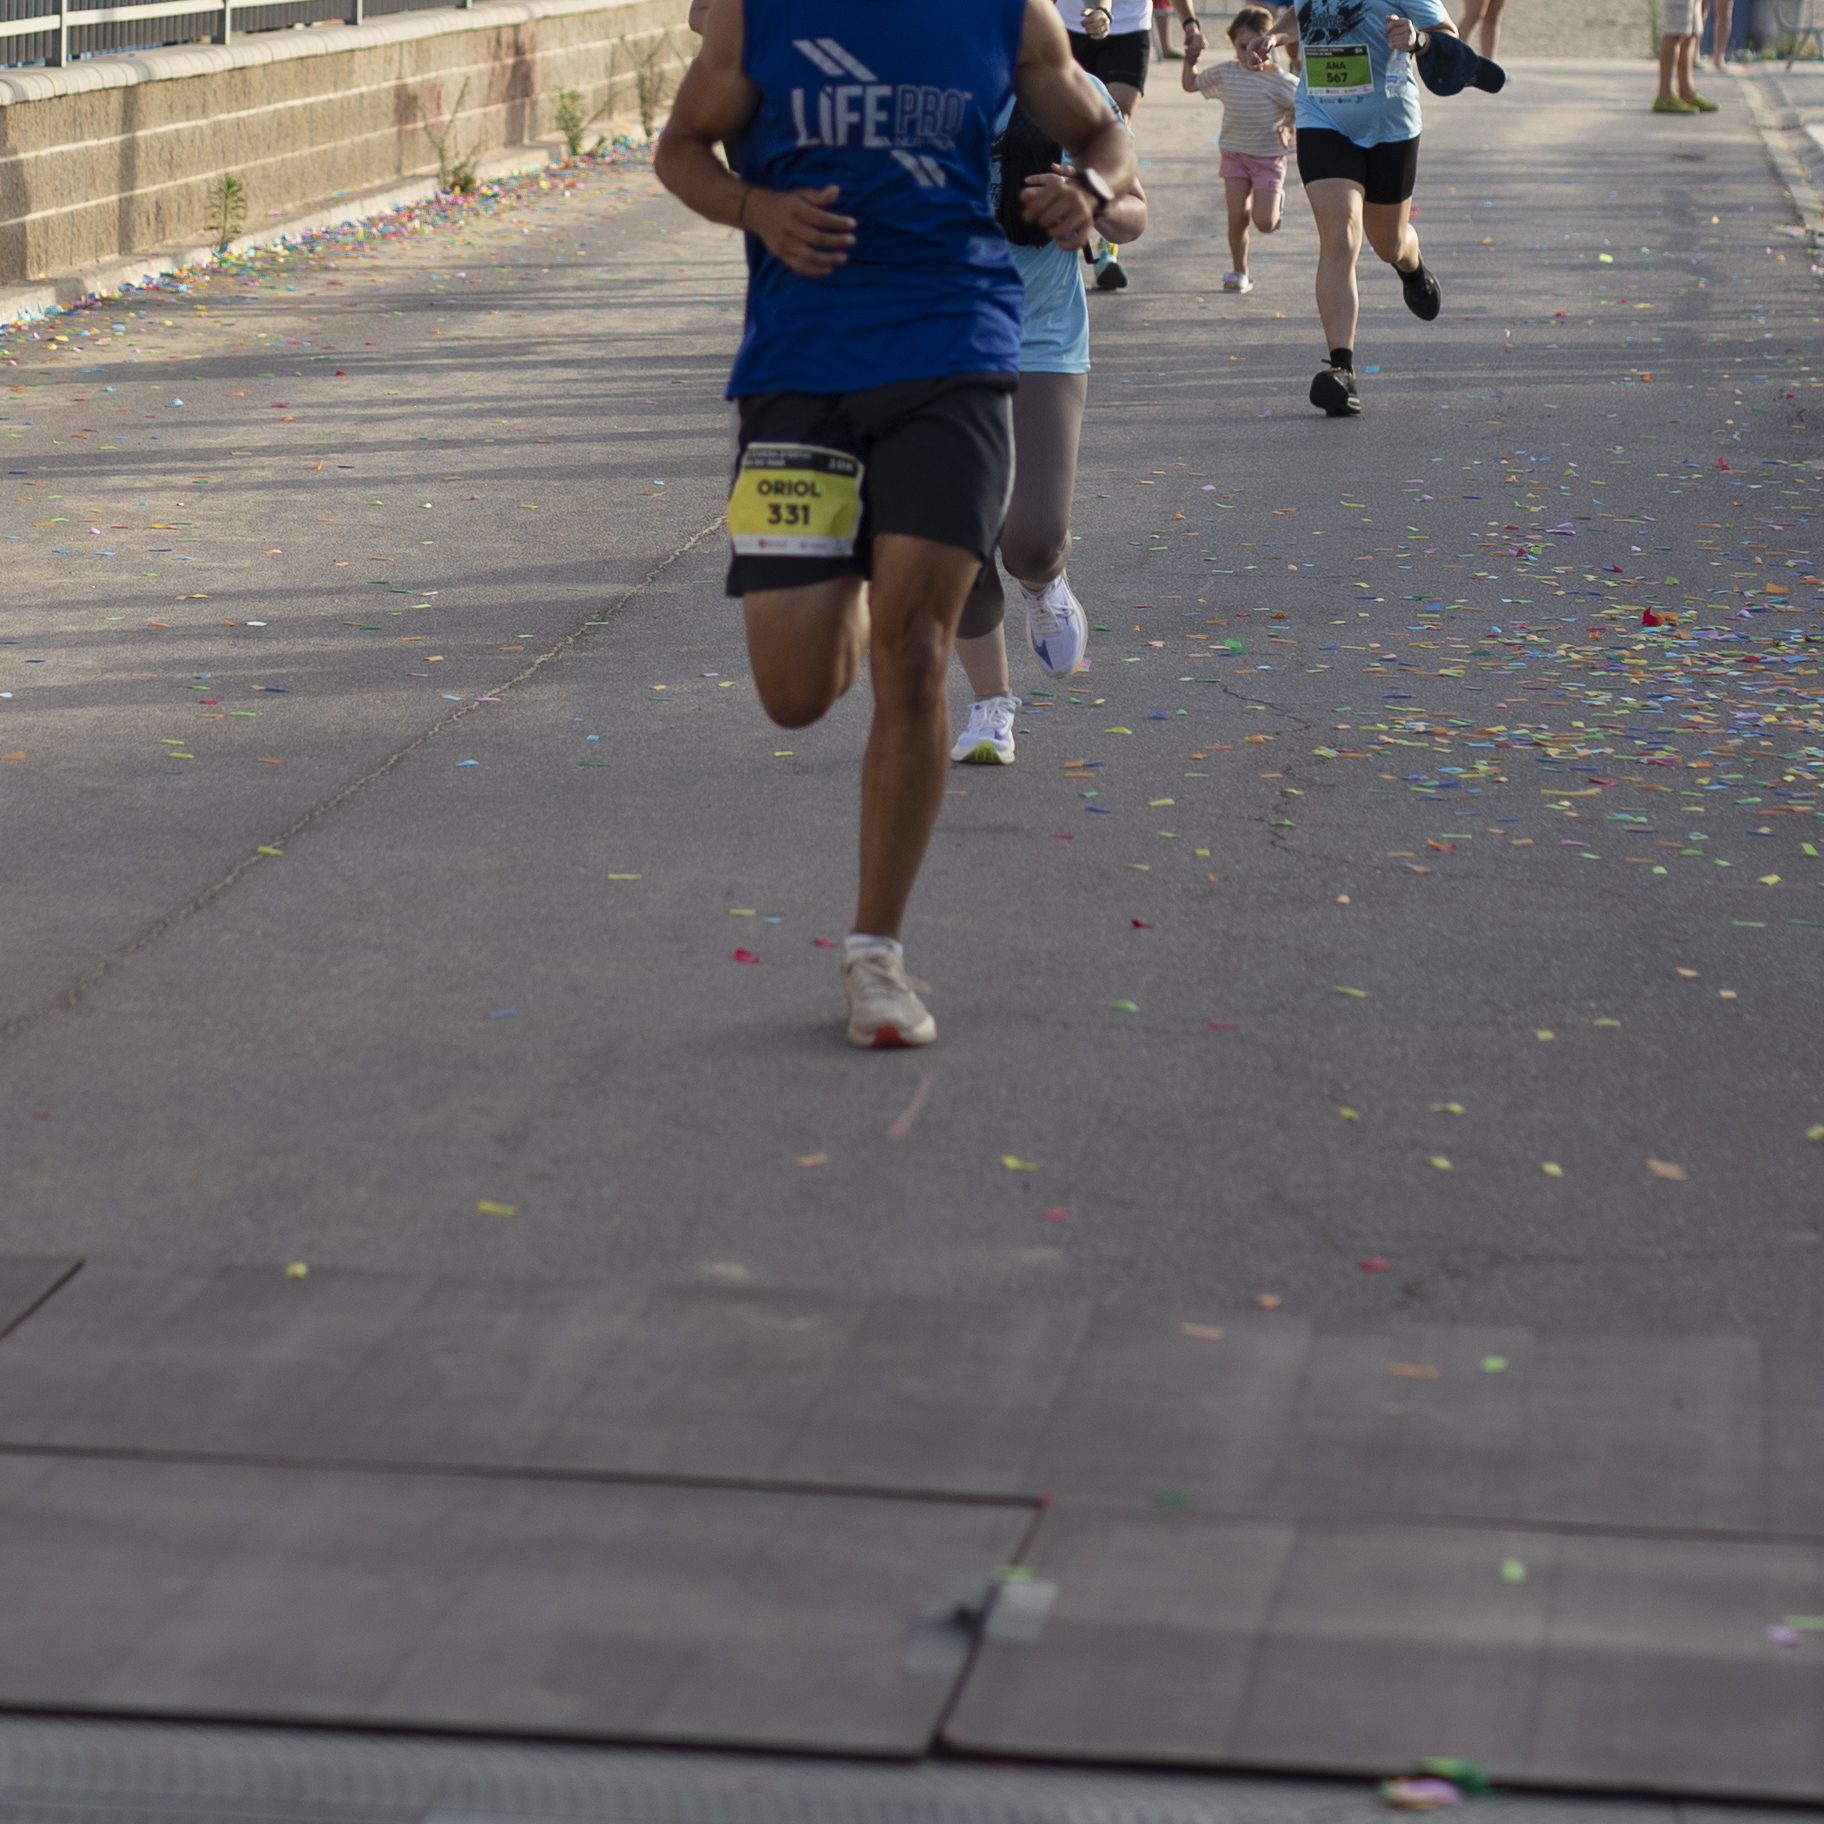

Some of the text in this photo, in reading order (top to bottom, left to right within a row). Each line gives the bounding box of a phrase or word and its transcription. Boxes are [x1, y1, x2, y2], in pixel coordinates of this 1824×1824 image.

[1325, 61, 1347, 70] ANA
[1326, 72, 1348, 83] 567
[893, 83, 967, 140] PRO
[757, 478, 823, 498] ORIOL
[767, 503, 810, 526] 331
